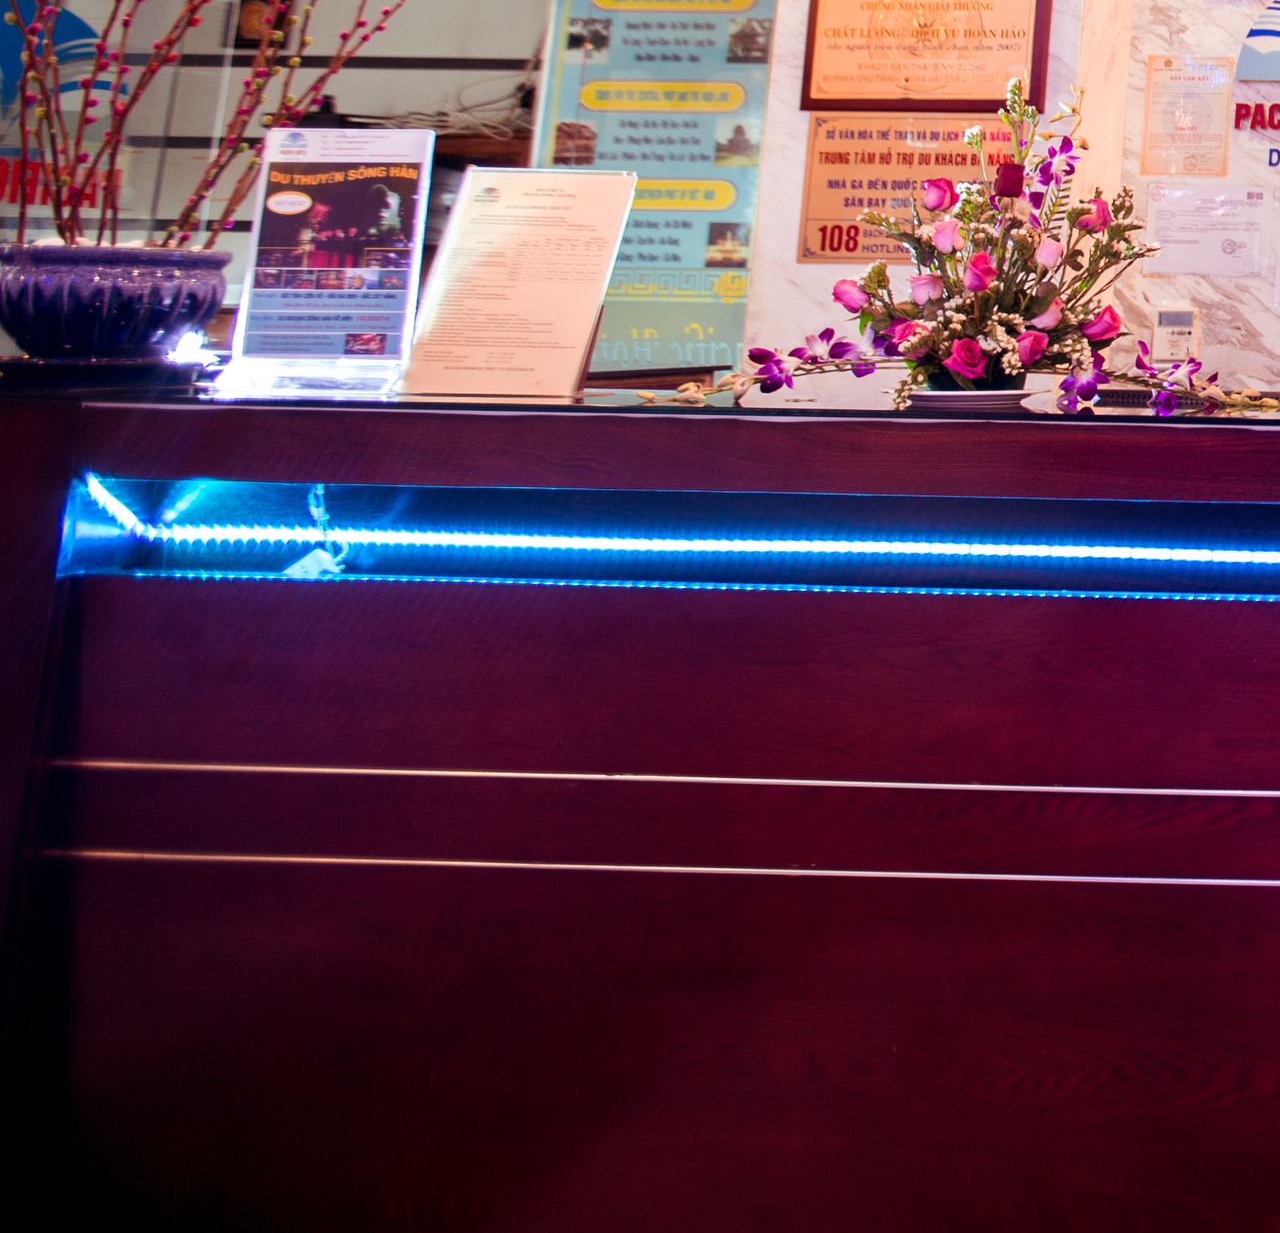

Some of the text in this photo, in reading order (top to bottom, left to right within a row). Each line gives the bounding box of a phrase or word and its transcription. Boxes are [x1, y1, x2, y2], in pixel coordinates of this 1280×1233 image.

[818, 151, 850, 165] TRUNG
[854, 148, 876, 165] TÂM
[934, 150, 968, 166] KHÁCH
[269, 170, 290, 185] DU
[346, 165, 387, 181] SÔNG
[389, 163, 418, 181] HÀN
[818, 224, 860, 253] 108
